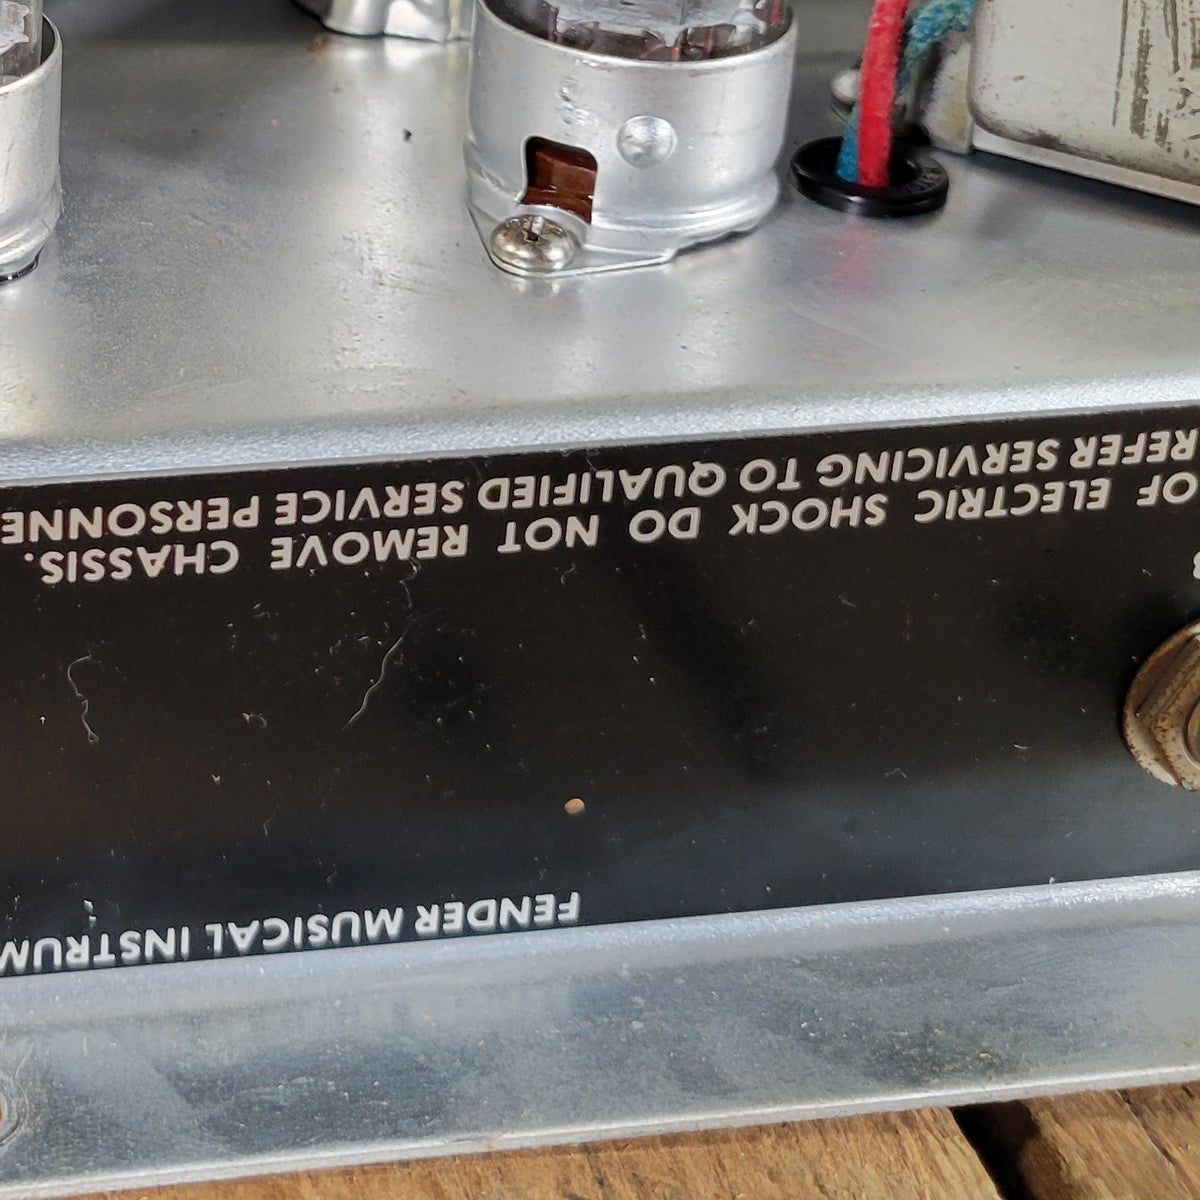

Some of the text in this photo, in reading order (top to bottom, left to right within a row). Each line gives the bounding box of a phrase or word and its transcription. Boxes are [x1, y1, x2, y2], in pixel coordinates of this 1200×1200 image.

[816, 438, 1060, 487] SERVICING
[1069, 429, 1198, 468] REFER
[477, 461, 725, 510] QUALIFIED
[739, 458, 800, 492] TO
[274, 480, 464, 525] SERVICE
[24, 472, 1198, 584] OF ELECTRIC SHOCK DO NOT REMOVE CHASSIS.
[205, 907, 404, 954] MUSICAL
[414, 891, 580, 935] FENDER
